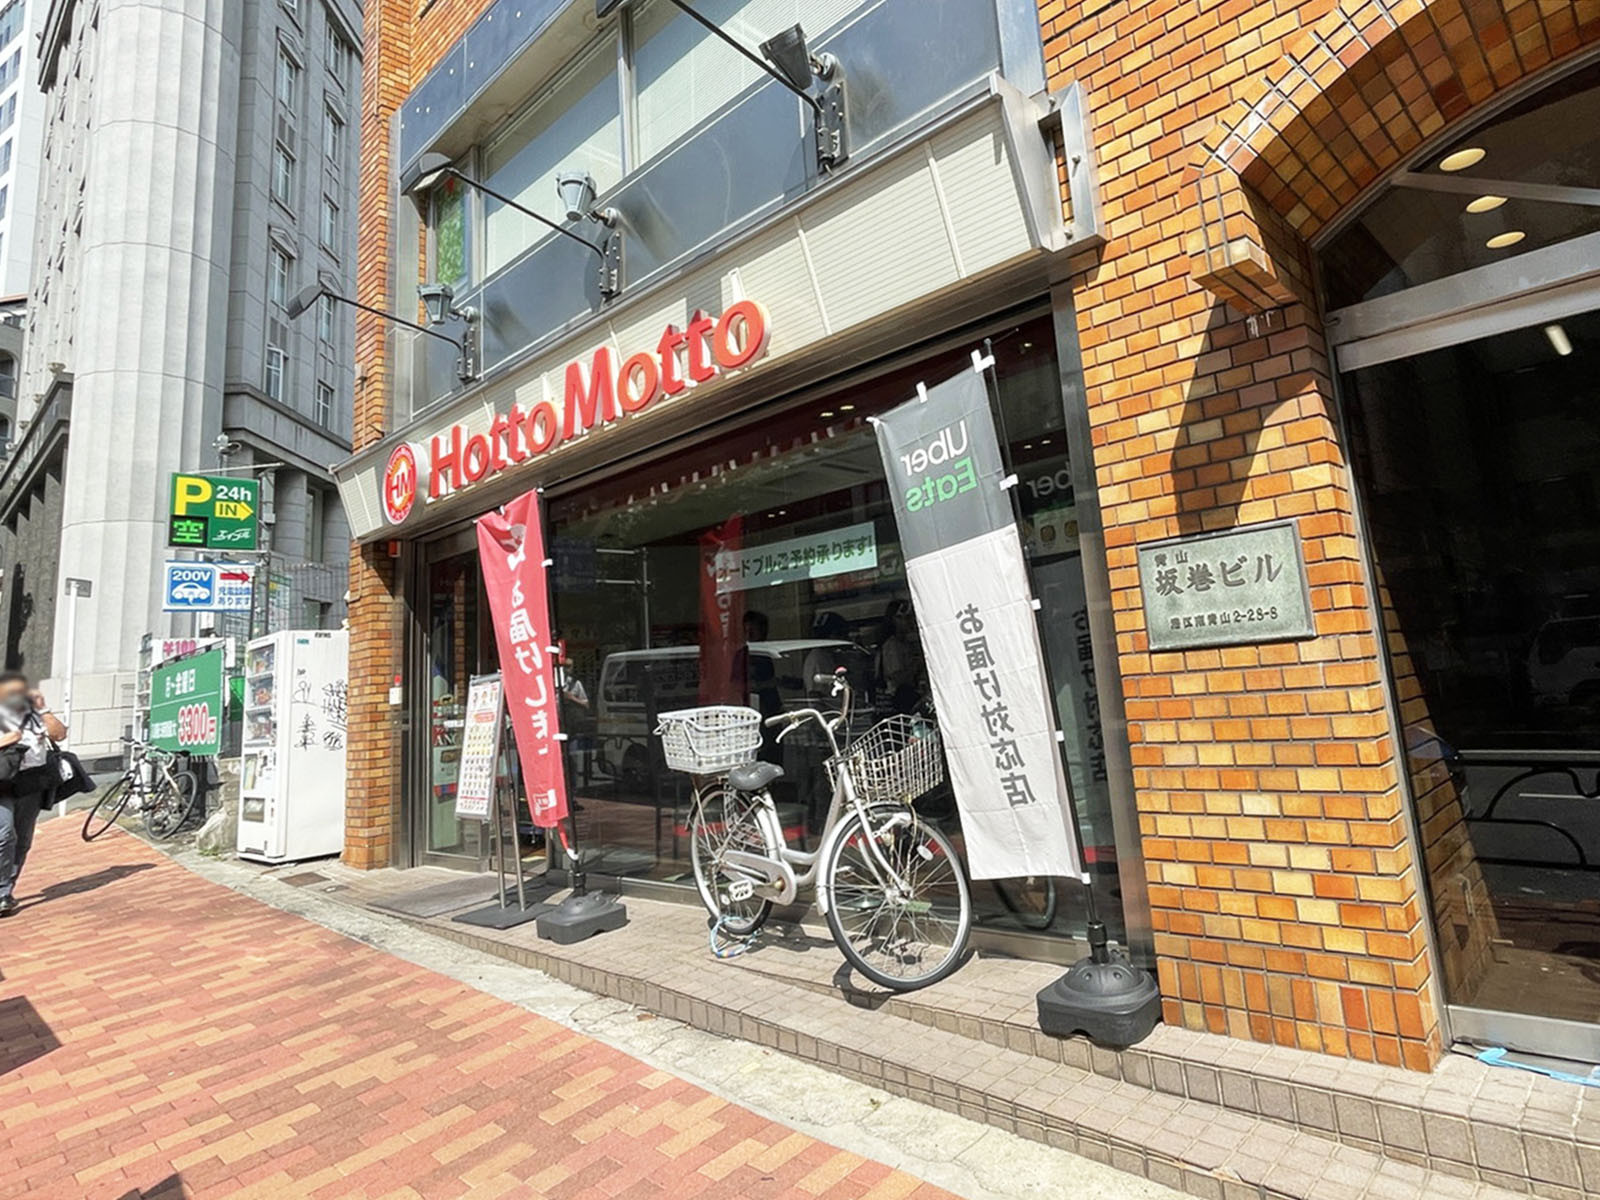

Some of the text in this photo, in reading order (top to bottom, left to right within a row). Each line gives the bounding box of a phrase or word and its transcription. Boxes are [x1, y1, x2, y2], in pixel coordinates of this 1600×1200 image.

[174, 476, 213, 516] P
[215, 485, 252, 501] 24h
[219, 503, 238, 516] IN
[172, 520, 204, 543] 空
[172, 570, 211, 582] 200V
[1155, 553, 1284, 597] 坂巻ビル
